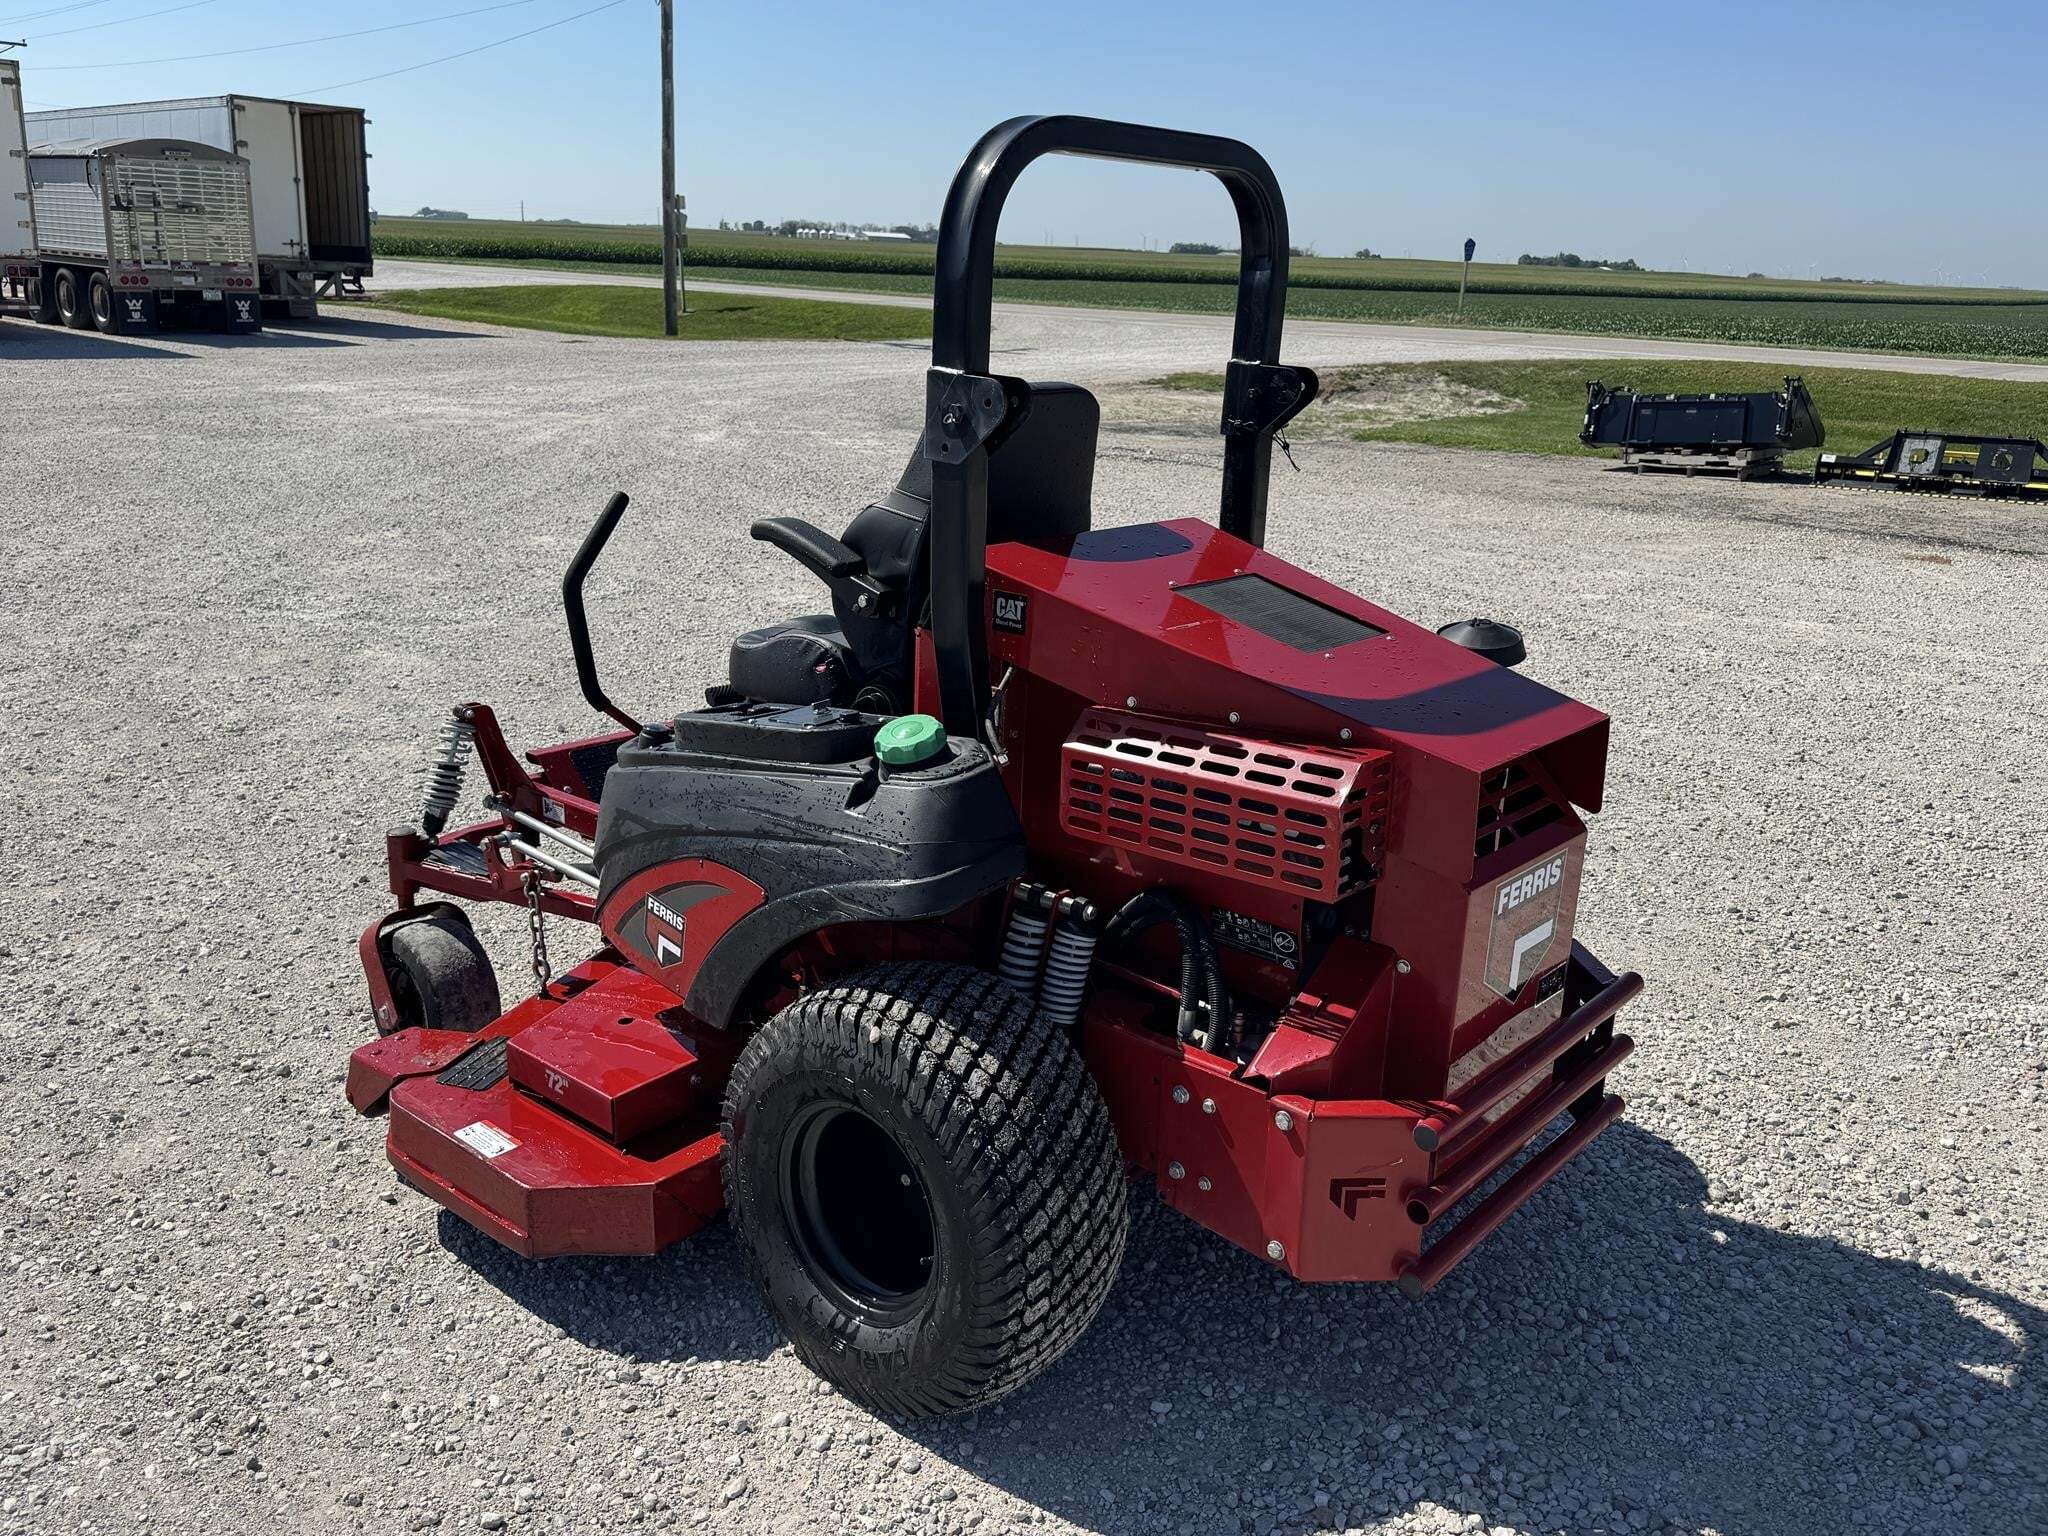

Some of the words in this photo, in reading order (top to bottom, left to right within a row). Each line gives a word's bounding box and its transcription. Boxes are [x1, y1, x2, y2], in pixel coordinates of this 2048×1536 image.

[996, 597, 1025, 620] CAT
[1498, 858, 1563, 916] FERRIS
[647, 896, 684, 931] FERRIS
